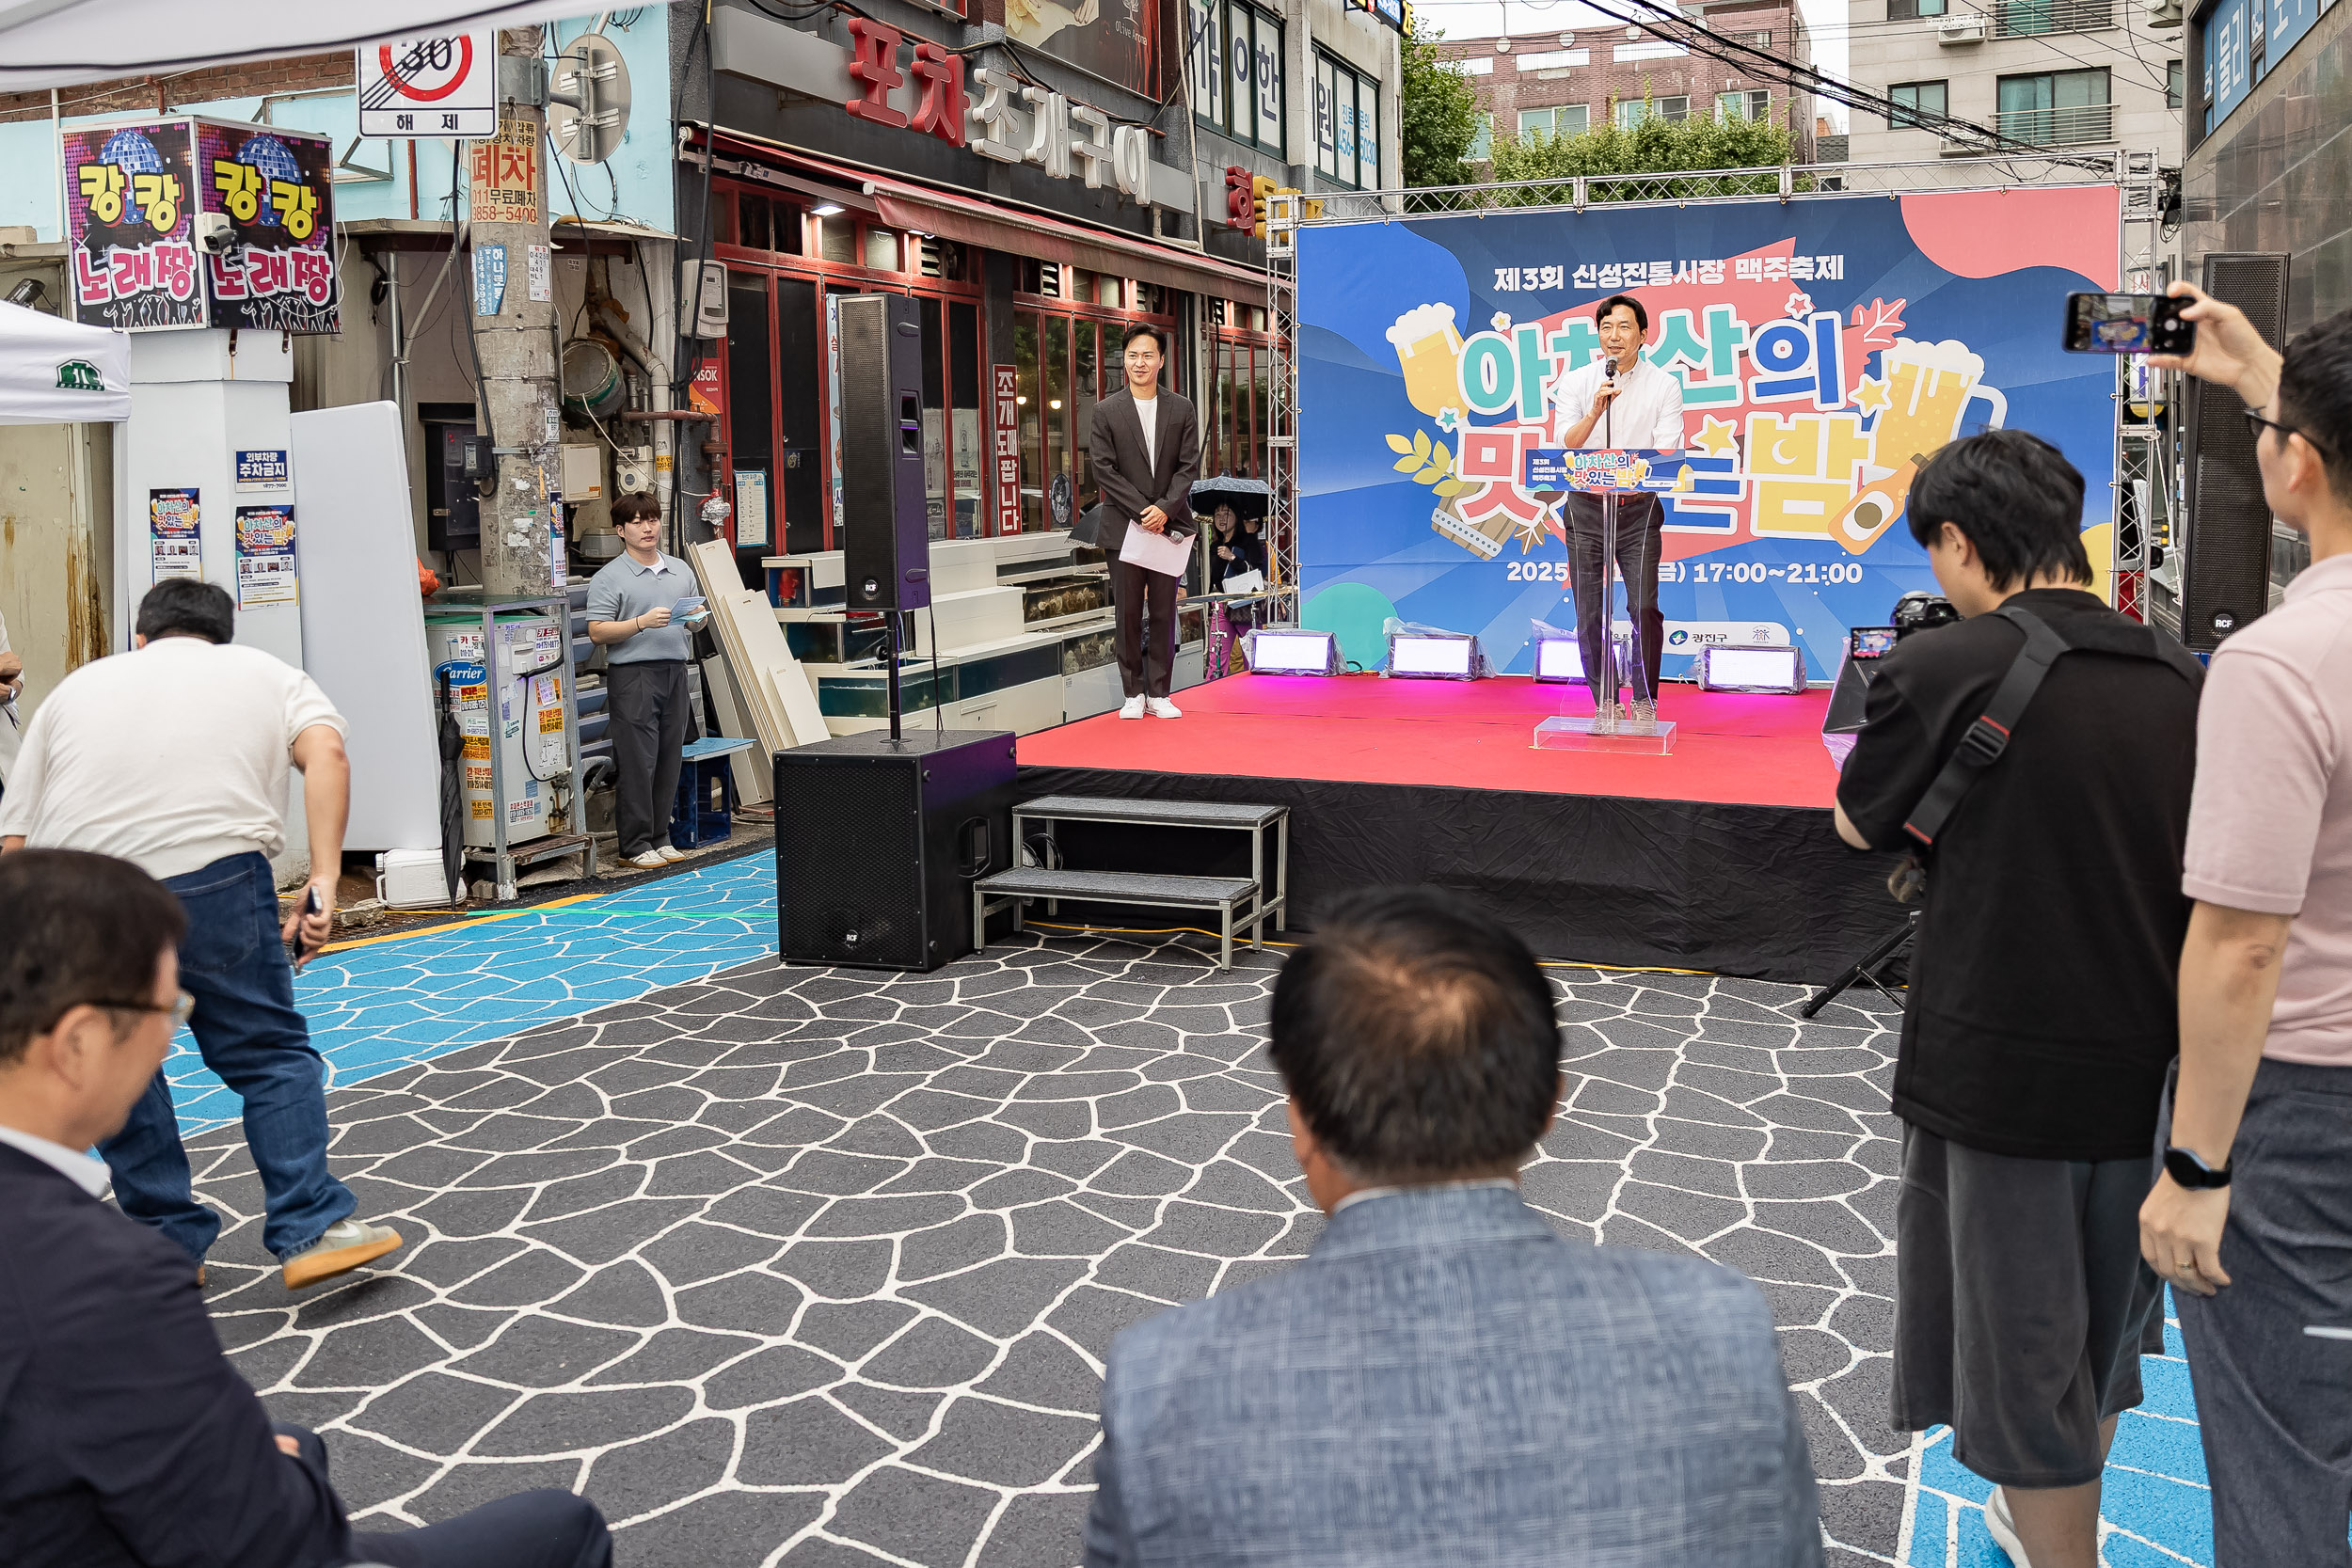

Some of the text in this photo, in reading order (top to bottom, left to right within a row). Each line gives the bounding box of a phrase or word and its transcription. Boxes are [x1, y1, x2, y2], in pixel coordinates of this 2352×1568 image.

[972, 67, 1150, 206] 조개구이
[472, 144, 536, 191] 폐차
[1493, 254, 1844, 292] 제3회 신성전통시장 맥주축제
[246, 451, 278, 463] 외부차량
[1574, 452, 1629, 469] 아차산의
[239, 462, 285, 477] 주차금지
[245, 517, 282, 531] 아차산의
[1692, 562, 1863, 583] 17:00~21:00
[2216, 619, 2233, 627] RCF
[1692, 633, 1728, 643] 광진구
